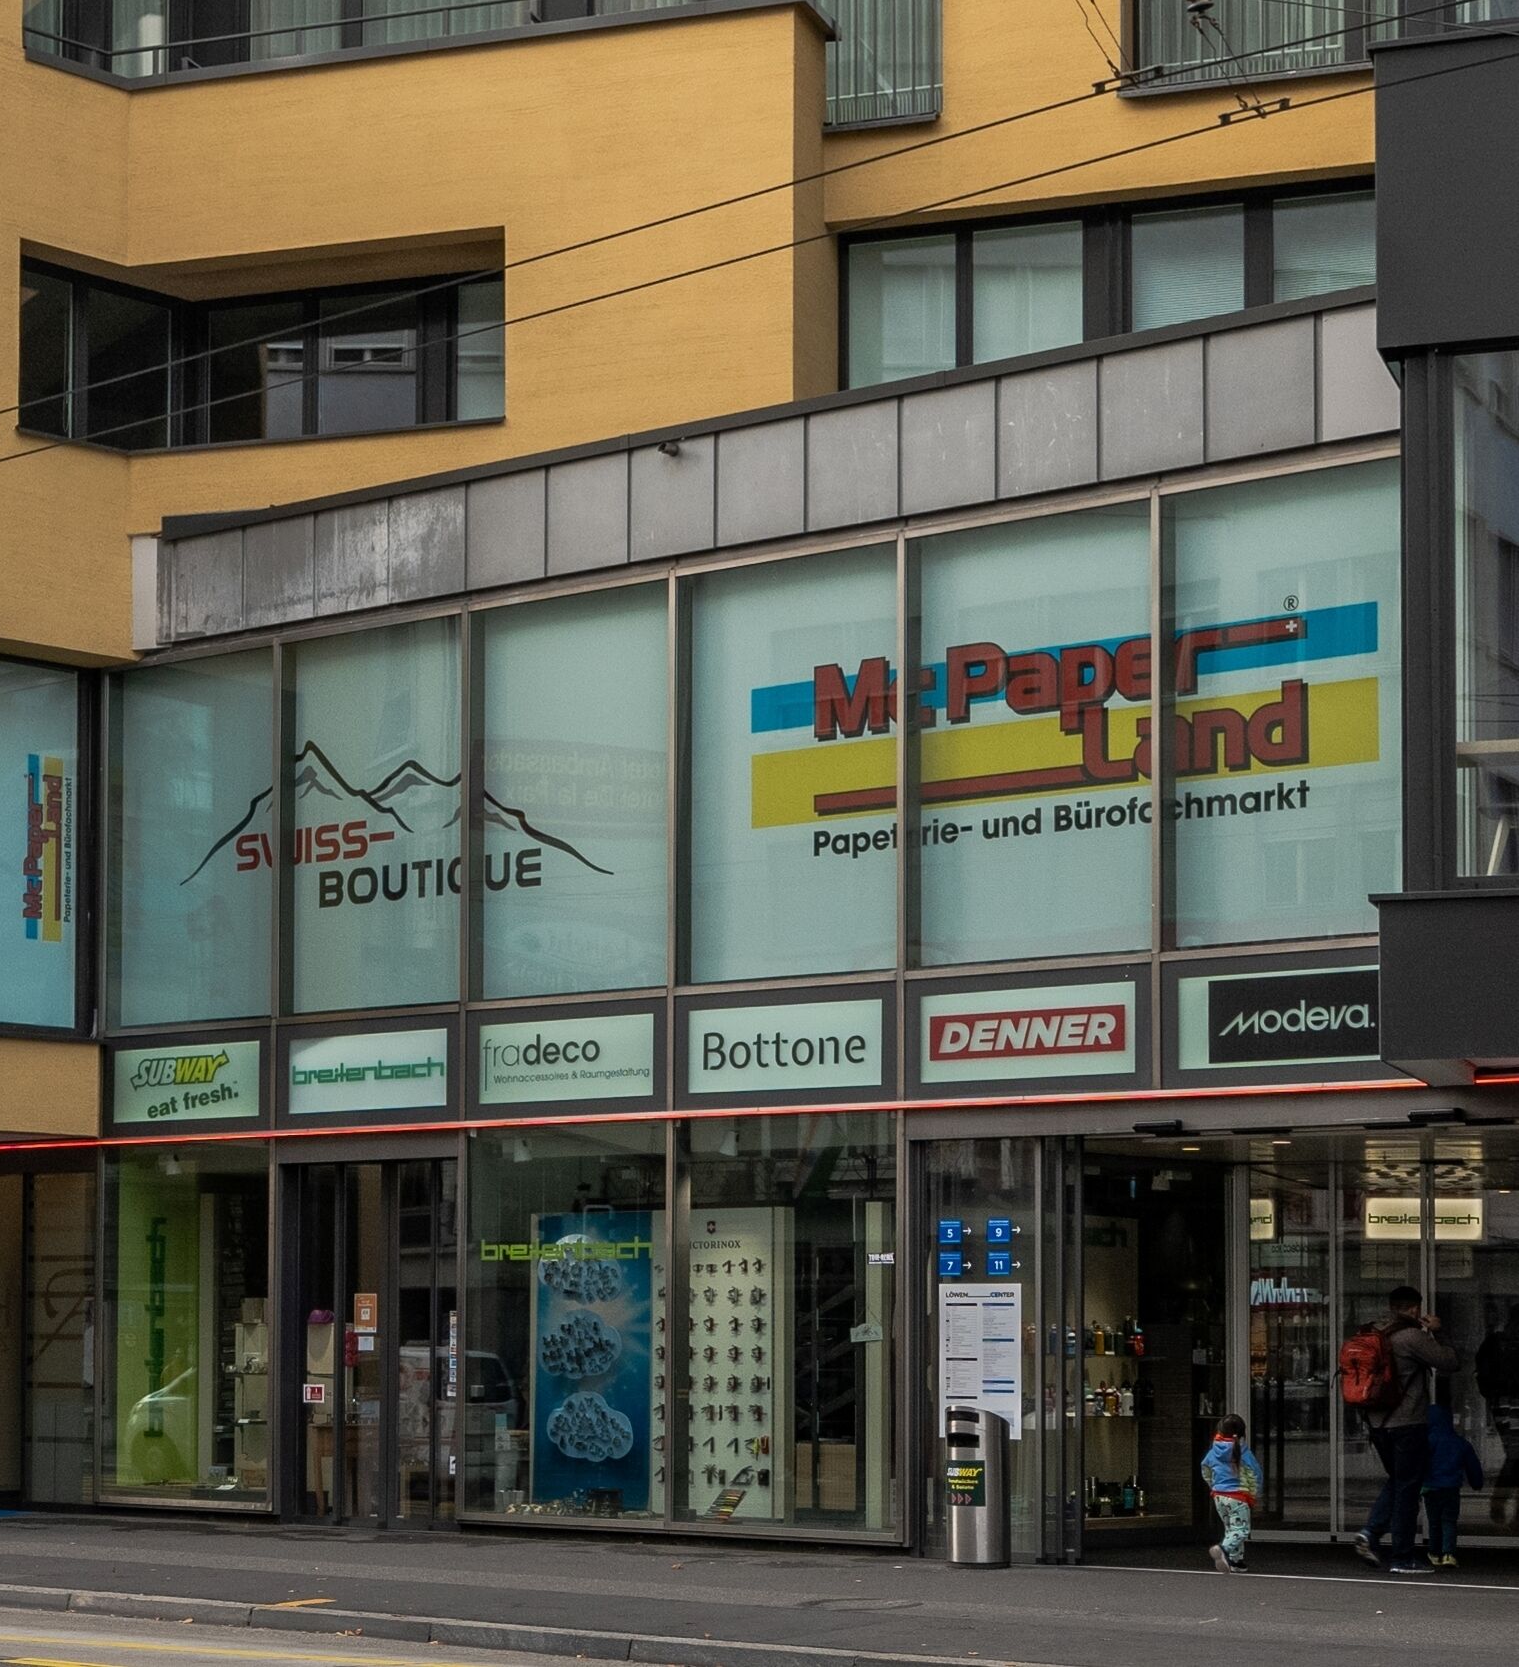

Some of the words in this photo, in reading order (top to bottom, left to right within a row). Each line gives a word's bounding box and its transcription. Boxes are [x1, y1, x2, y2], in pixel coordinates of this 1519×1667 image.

[814, 656, 937, 742] Mc
[946, 619, 1270, 736] Paper
[1083, 679, 1309, 782] Land
[814, 818, 973, 859] Papetrie-
[982, 807, 1042, 839] und
[937, 1012, 1118, 1056] DENNER
[482, 1033, 601, 1092] fradeco
[701, 1030, 866, 1072] Bottone
[130, 1050, 230, 1091] SUBWAY
[291, 1056, 445, 1085] breitenbach
[493, 1071, 569, 1085] Wohnaccessoires
[571, 1070, 579, 1080] &
[580, 1067, 650, 1079] Raumgestaltung
[147, 1096, 179, 1119] eat
[183, 1083, 239, 1110] fresh.
[946, 1228, 954, 1238] 5
[995, 1227, 1003, 1237] 9
[1368, 1213, 1480, 1225] breitebach
[688, 1239, 742, 1251] ICTORINOX
[946, 1261, 954, 1271] 7
[994, 1260, 1004, 1270] 11
